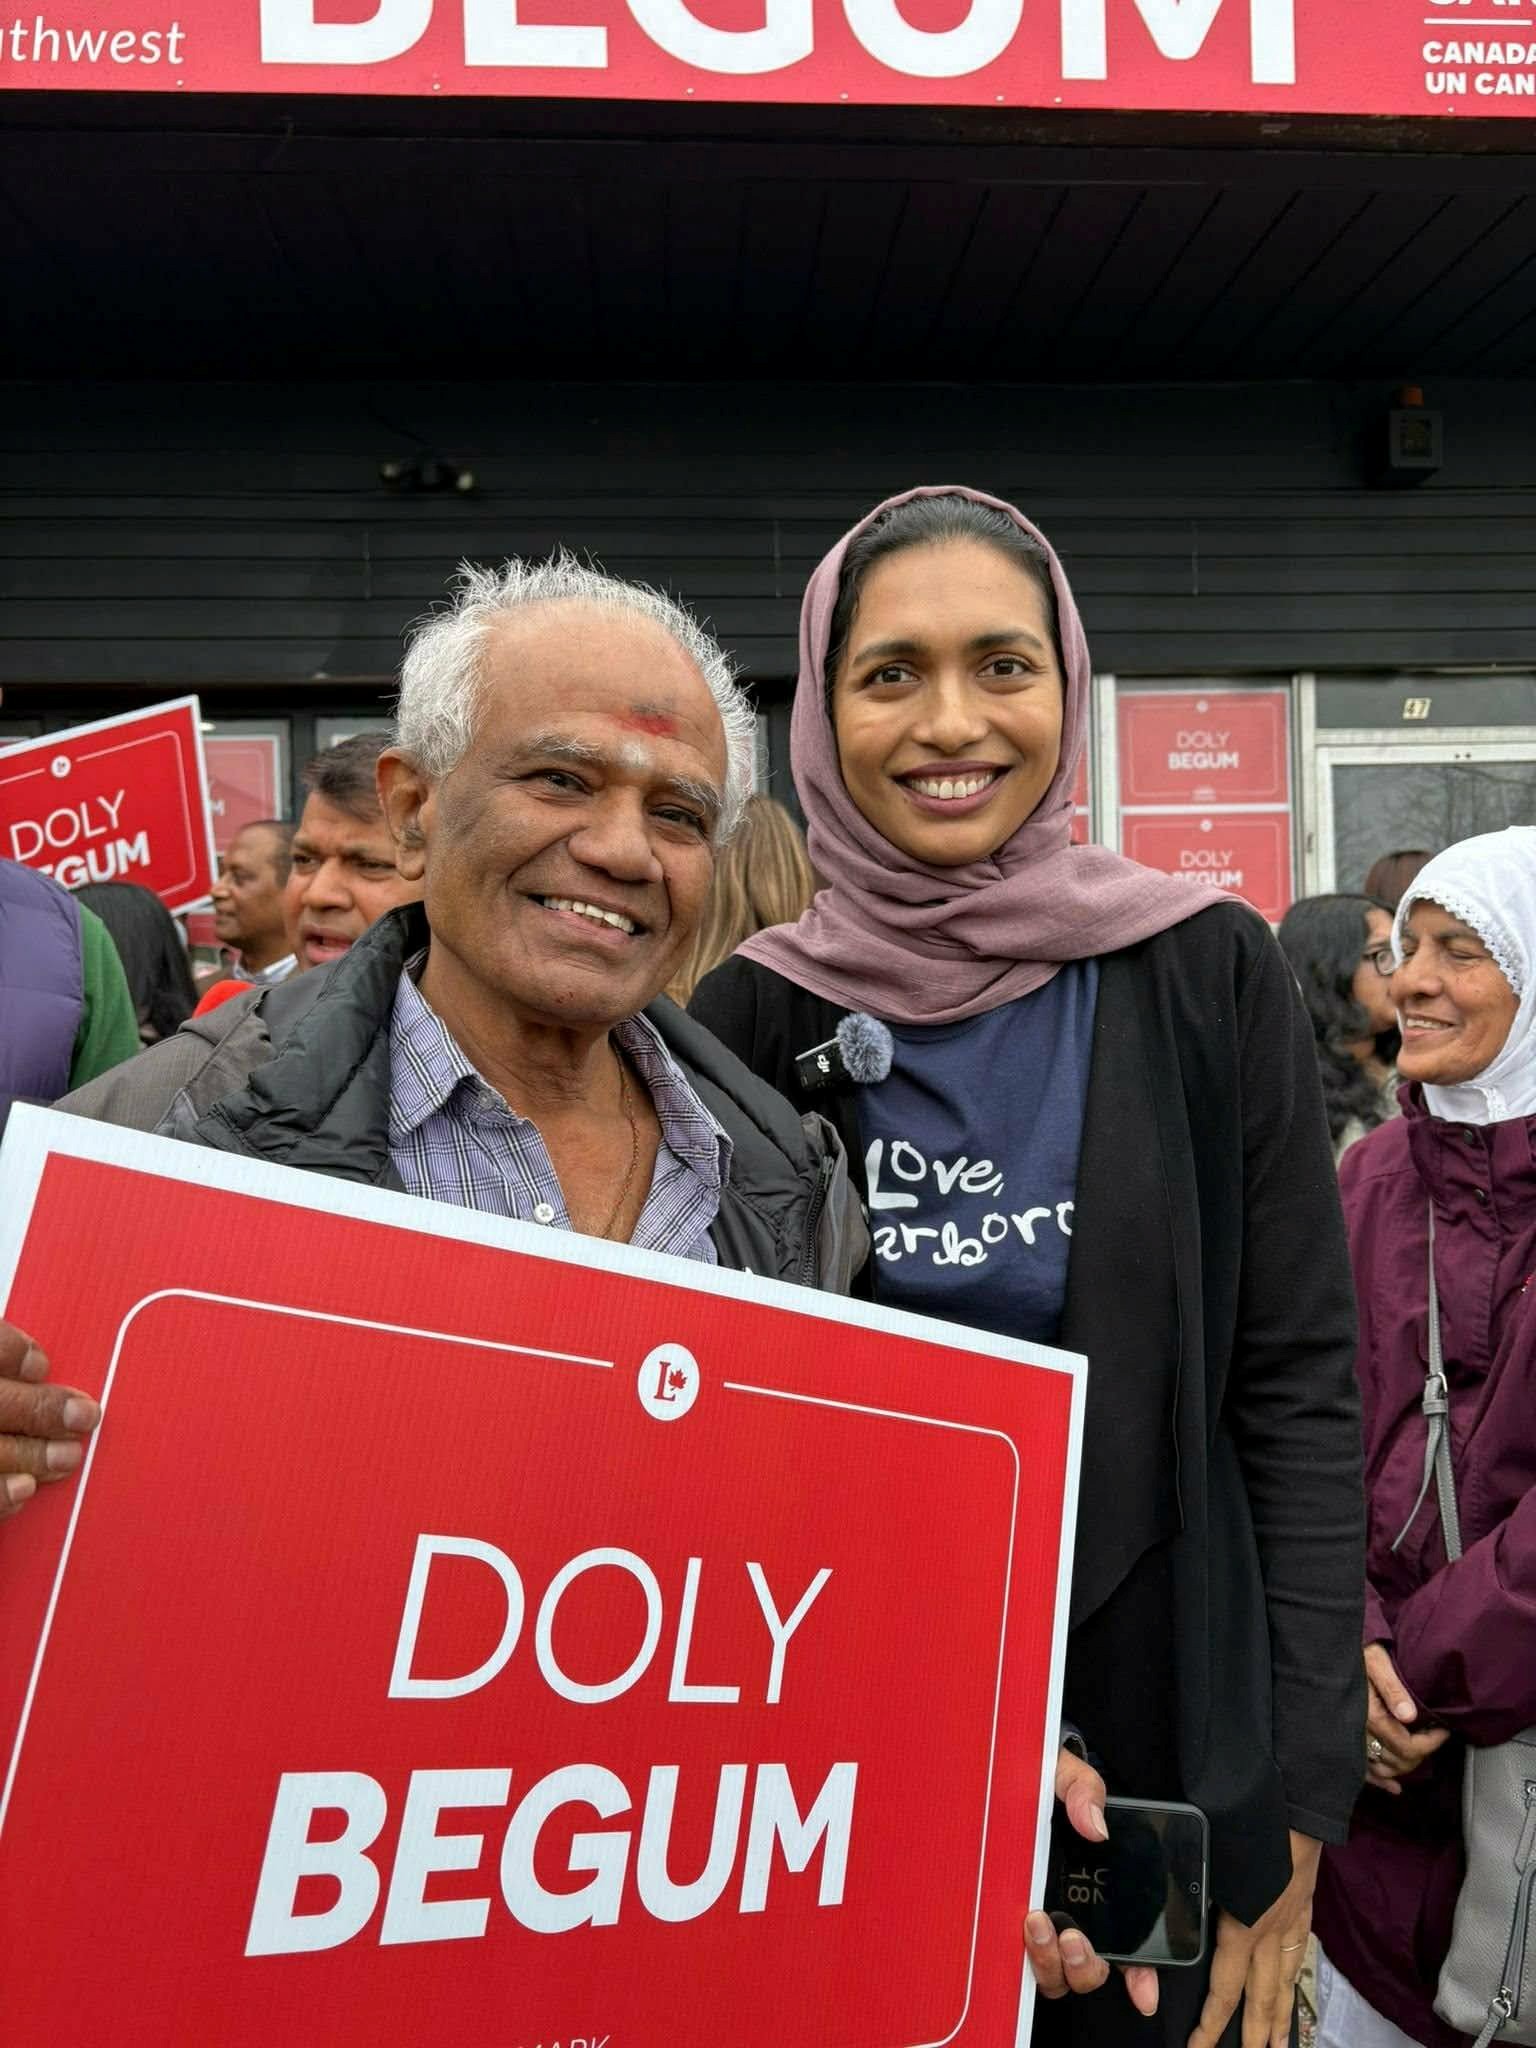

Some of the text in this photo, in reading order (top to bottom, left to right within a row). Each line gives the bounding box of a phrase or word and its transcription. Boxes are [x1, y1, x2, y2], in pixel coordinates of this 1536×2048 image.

[1425, 71, 1536, 96] UN CAN
[1175, 731, 1231, 749] DOLY
[1167, 751, 1240, 770] BEGUM
[9, 789, 125, 862] DOLY
[37, 830, 152, 890] GUM
[1179, 849, 1233, 869] DOLY
[387, 1532, 834, 1705] DOLY
[243, 1761, 859, 1957] BEGUM
[1067, 1866, 1091, 1903] 18
